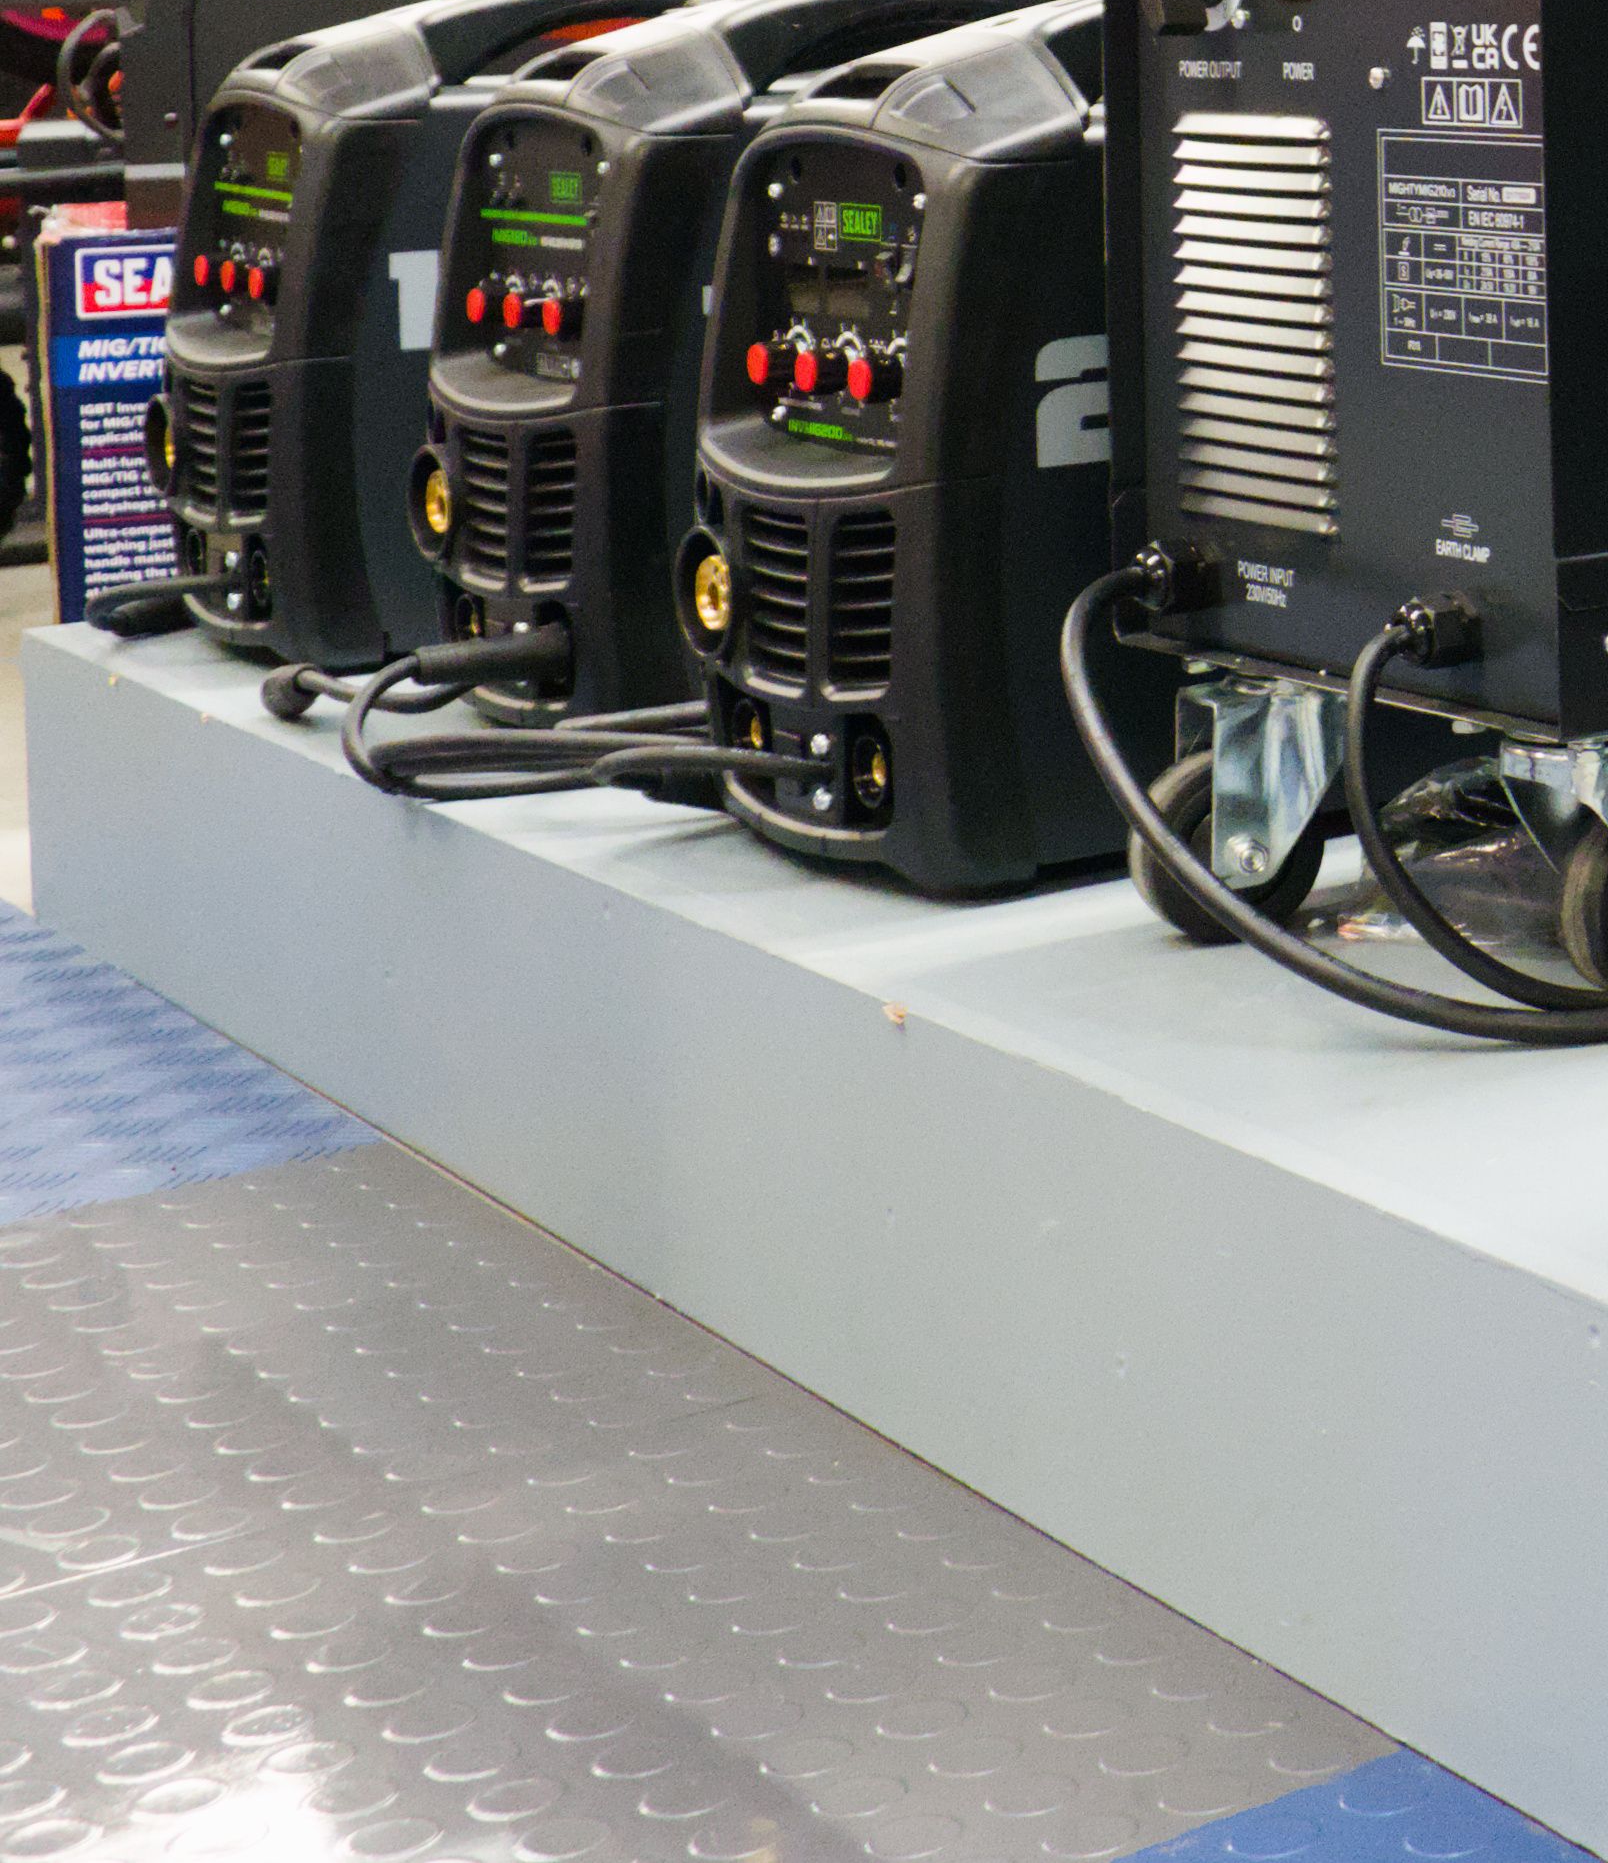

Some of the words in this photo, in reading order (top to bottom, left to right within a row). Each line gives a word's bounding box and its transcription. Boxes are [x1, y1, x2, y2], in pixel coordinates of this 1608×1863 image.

[1472, 24, 1499, 46] UK
[1472, 46, 1500, 69] CA
[1179, 60, 1209, 79] POWER
[1210, 61, 1243, 80] OUTPUT
[1283, 62, 1314, 82] POWER
[1466, 185, 1488, 202] Serial
[842, 208, 879, 237] SEALEY
[1468, 210, 1480, 227] EN
[1481, 211, 1494, 228] IEC
[80, 401, 114, 417] IGBT
[80, 416, 100, 431] for
[81, 469, 139, 486] MIG/TIG
[82, 485, 141, 503] compact
[82, 497, 155, 517] bodyshops
[84, 538, 146, 556] weighing
[1435, 538, 1462, 557] EARTH
[1463, 544, 1491, 564] CLAMP
[84, 553, 130, 569] handle
[85, 567, 141, 586] allowing
[145, 565, 168, 580] the
[1238, 560, 1268, 583] POWER
[1269, 567, 1295, 587] INPUT
[1246, 584, 1287, 608] 230V/50Hz
